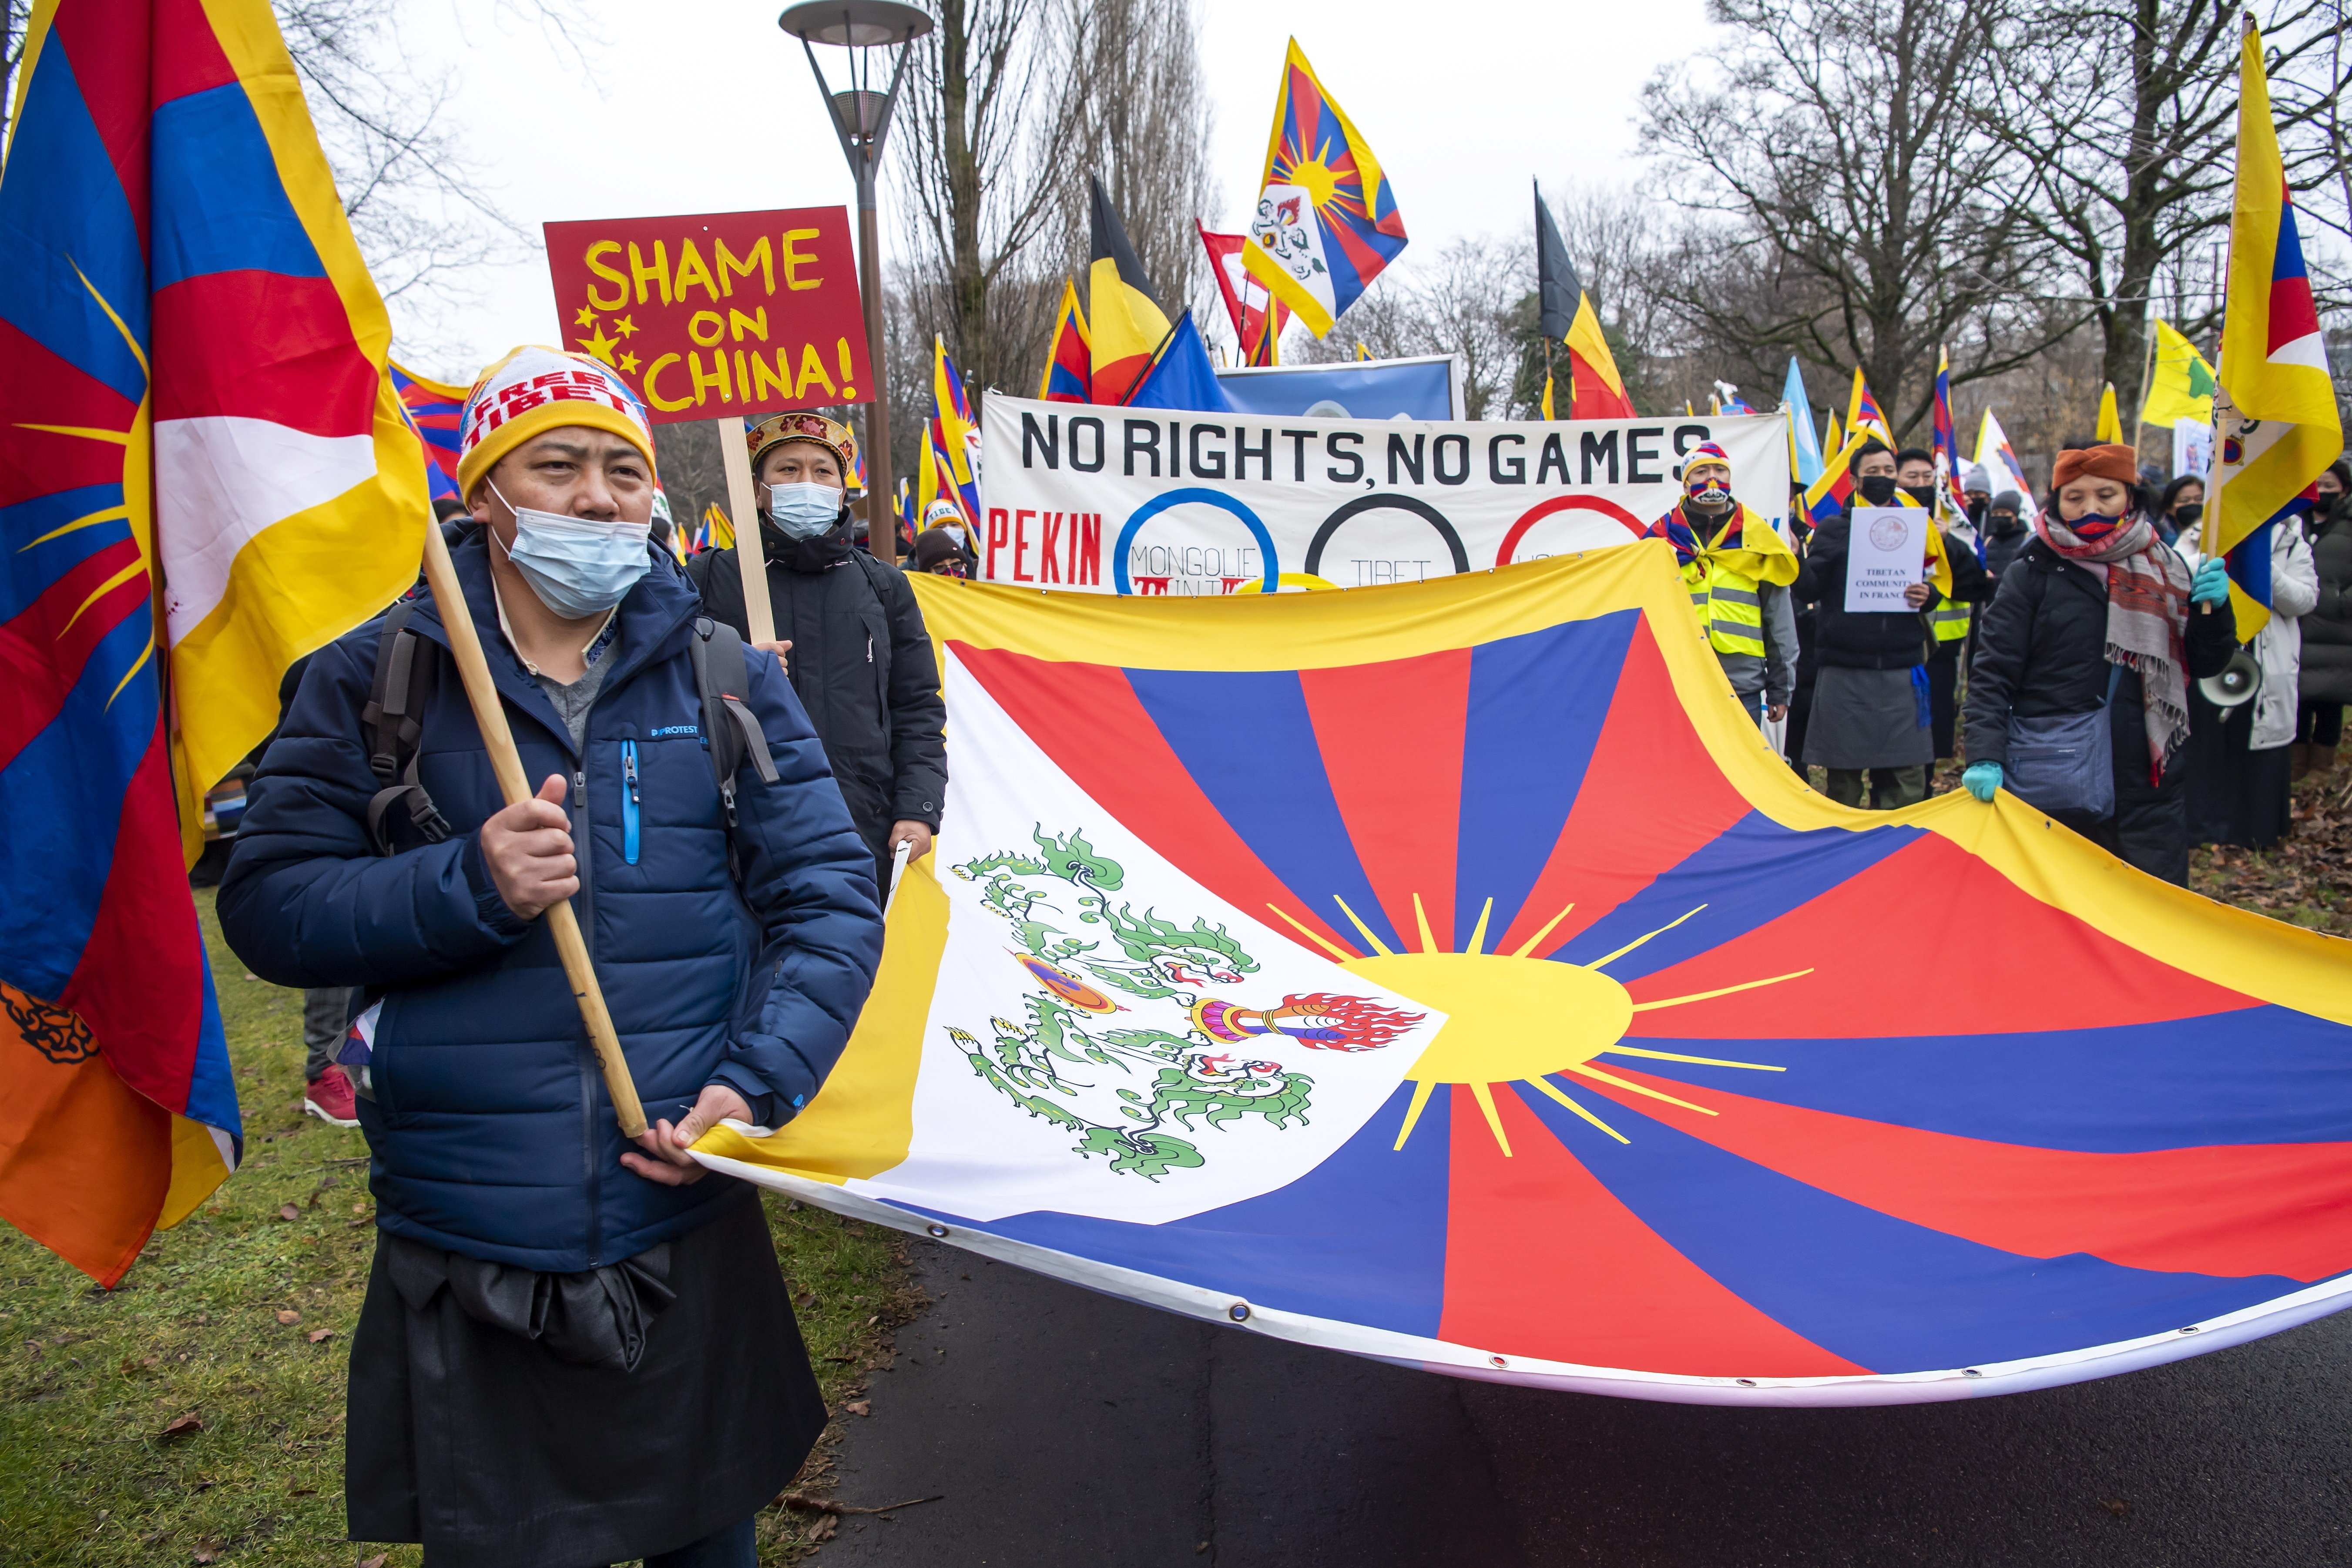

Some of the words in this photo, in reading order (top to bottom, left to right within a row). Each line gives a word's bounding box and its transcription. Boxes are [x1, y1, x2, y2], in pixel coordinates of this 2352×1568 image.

[584, 228, 824, 311] SHAME
[688, 306, 768, 347] ON
[643, 336, 856, 412] CHINA!
[1021, 412, 1104, 473] NO
[1124, 419, 1375, 490] RIGHTS,
[1388, 433, 1470, 485] NO
[1488, 425, 1711, 484] GAMES
[986, 508, 1101, 586] PEKIN
[1132, 546, 1258, 577] MONGOLIE
